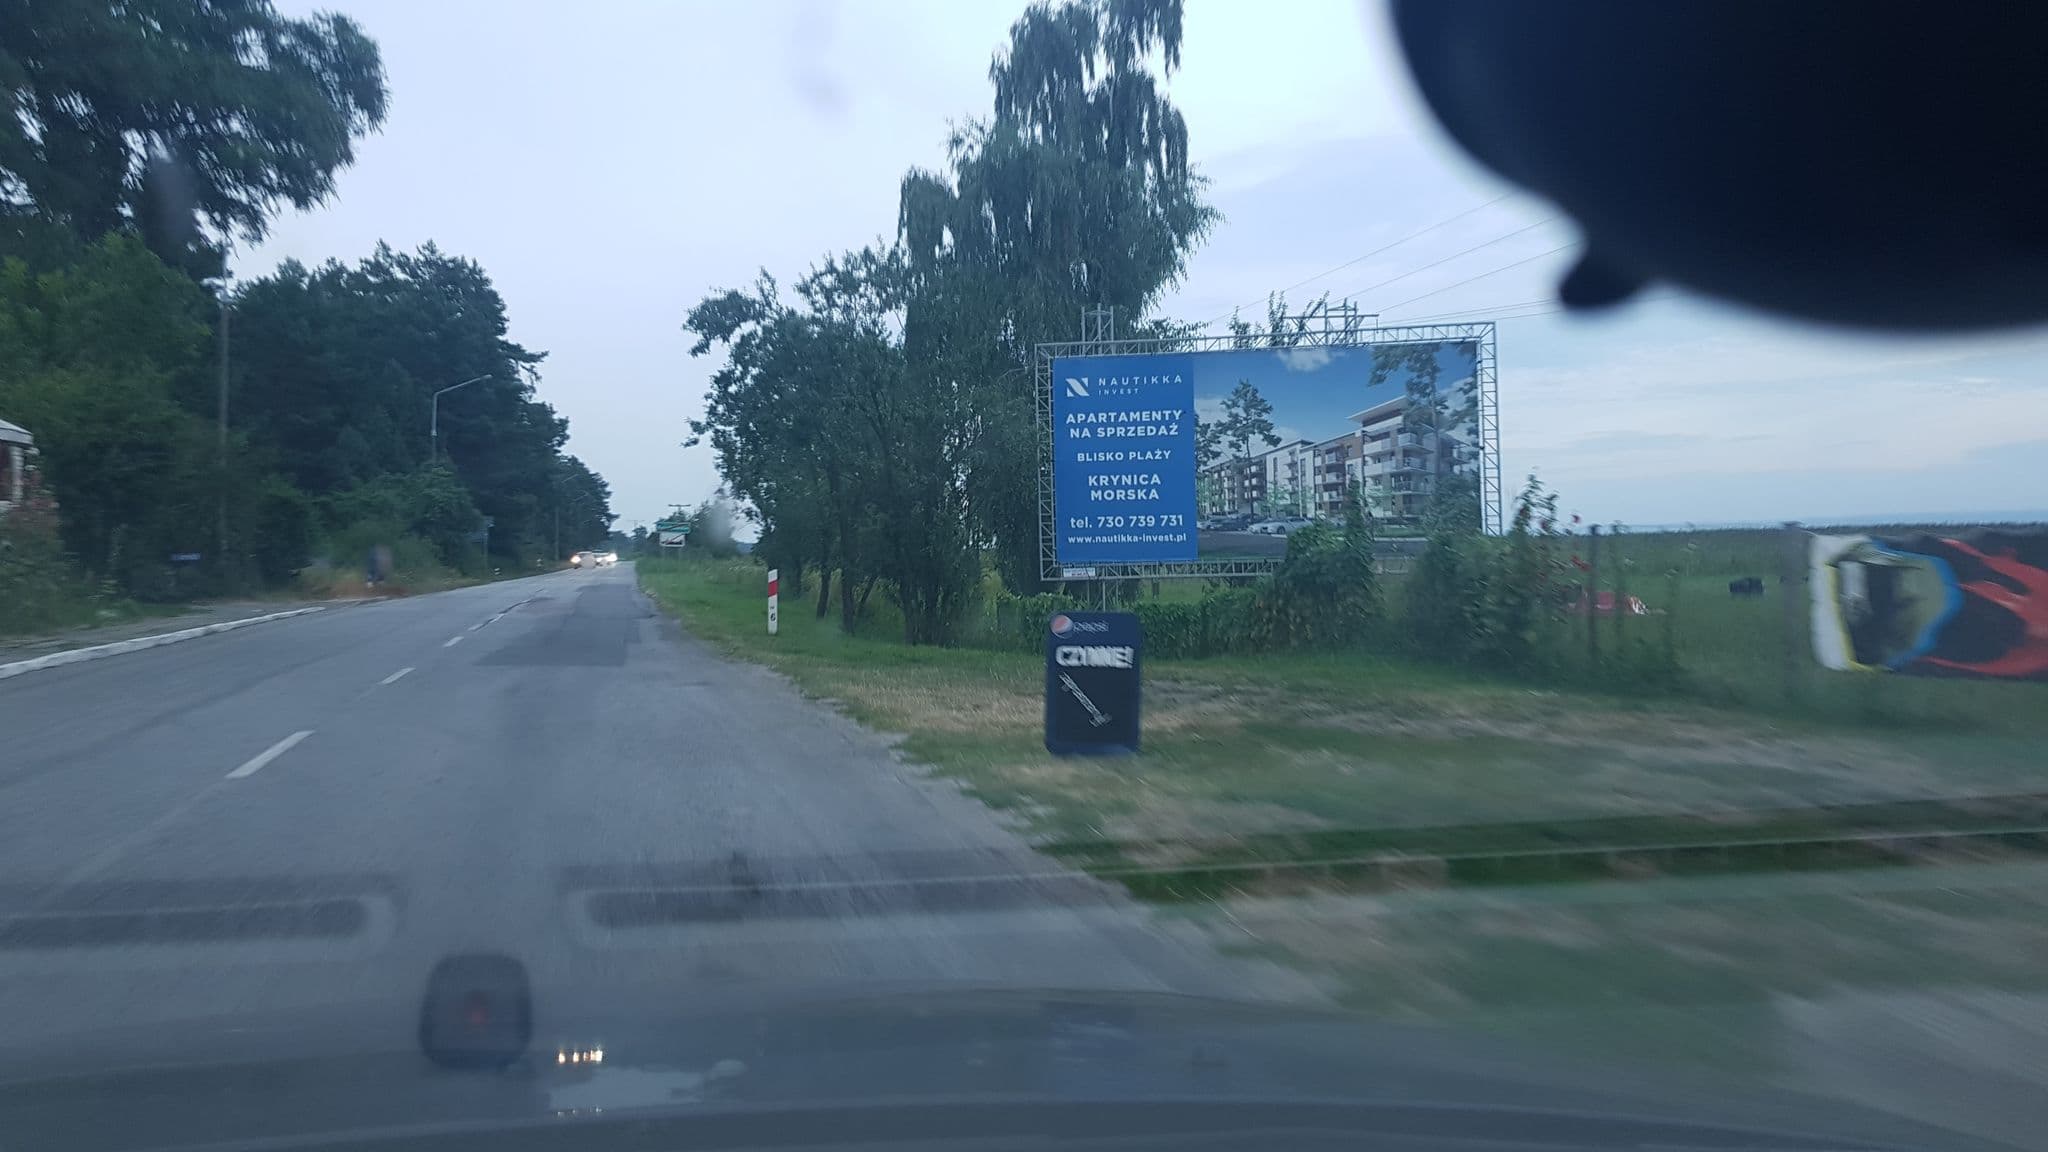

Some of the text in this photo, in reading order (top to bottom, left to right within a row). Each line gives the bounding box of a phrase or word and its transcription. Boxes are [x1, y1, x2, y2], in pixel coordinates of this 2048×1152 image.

[1098, 375, 1183, 386] NAUTIKKA
[1098, 388, 1139, 396] INVEST
[1066, 409, 1182, 424] APARTAMENTY
[1070, 423, 1179, 438] NA SPRZEDAŻ
[1077, 448, 1172, 462] BLISKO PLAŻY
[1088, 474, 1161, 487] KRYNICA
[1091, 488, 1159, 501] MORSKA
[1070, 514, 1183, 528] tel. 730 739 731
[1068, 532, 1187, 544] www.nautikka-invest.pl
